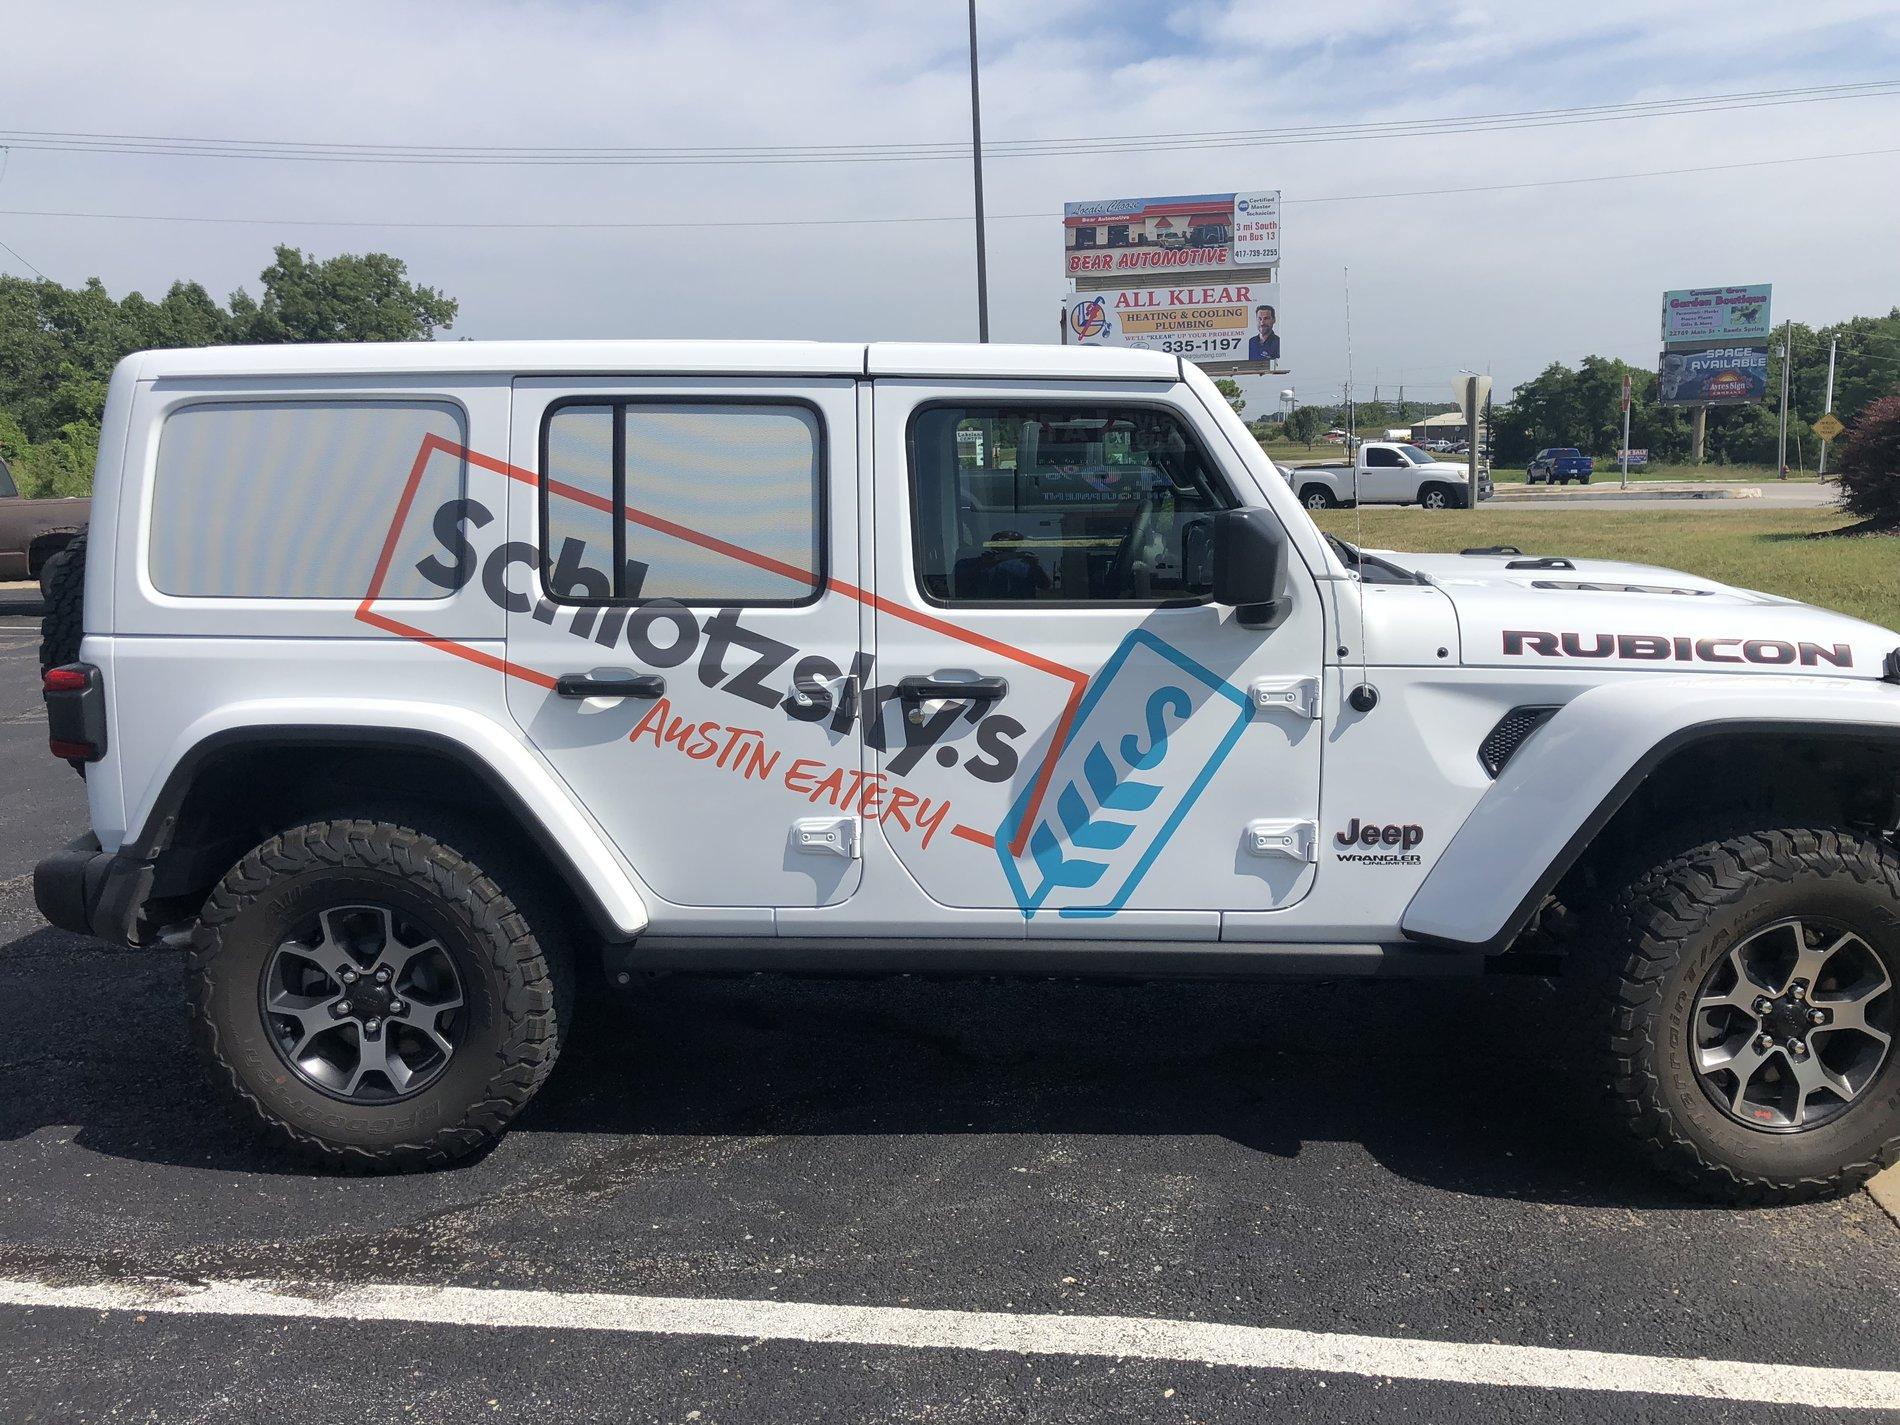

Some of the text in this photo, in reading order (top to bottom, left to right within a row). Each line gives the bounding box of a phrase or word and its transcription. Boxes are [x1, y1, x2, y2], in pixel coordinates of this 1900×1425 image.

[1236, 220, 1278, 231] 3 mi South
[1237, 232, 1276, 242] on Bus 13
[1069, 248, 1228, 271] BEAR AUTOMOTIVE
[1235, 249, 1278, 258] 417-739-2255
[1115, 286, 1252, 308] ALL KLEAR
[1670, 294, 1767, 309] Garden Boutique
[1126, 308, 1243, 322] HEATING & COOLING
[1155, 319, 1214, 330] PLUMBING
[1146, 333, 1175, 341] "KLEAR"
[1187, 331, 1207, 339] YOUR
[1208, 330, 1245, 338] PROBLEMS
[1162, 338, 1242, 353] 335-1197
[1706, 347, 1752, 358] SPACE
[1692, 357, 1766, 369] AVAILABLE
[414, 494, 1027, 785] Schlotzsky's
[1502, 630, 1854, 668] RUBICON
[785, 752, 952, 851] EATERY
[1336, 817, 1424, 851] Jeep
[1336, 854, 1422, 862] WRANGLER
